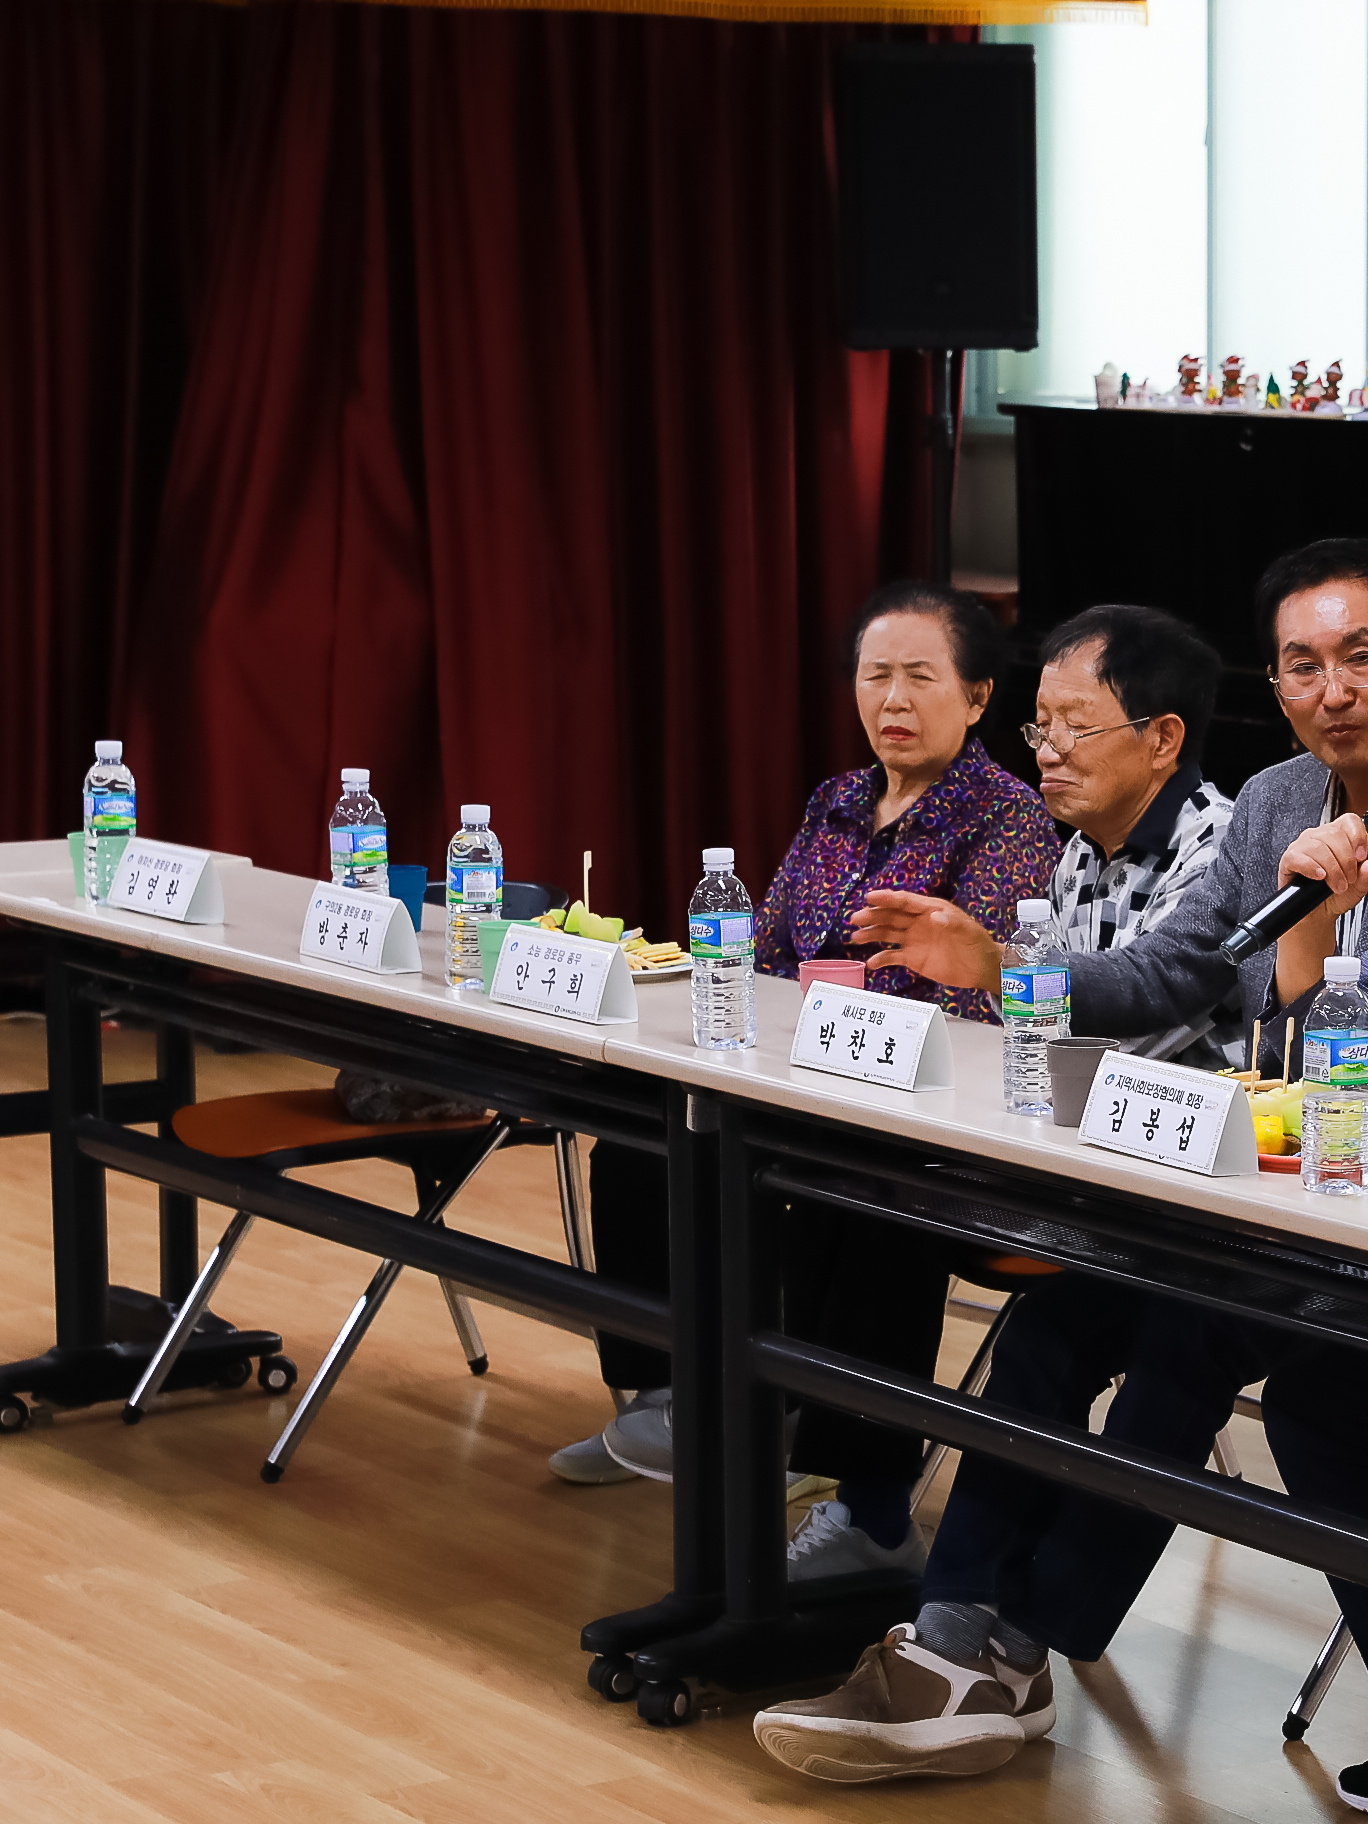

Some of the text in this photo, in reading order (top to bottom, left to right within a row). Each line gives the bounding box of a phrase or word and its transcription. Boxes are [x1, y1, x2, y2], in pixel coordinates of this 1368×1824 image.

[868, 1009, 886, 1026] 회장
[1115, 1074, 1204, 1110] 지역사회보장협의체 회장
